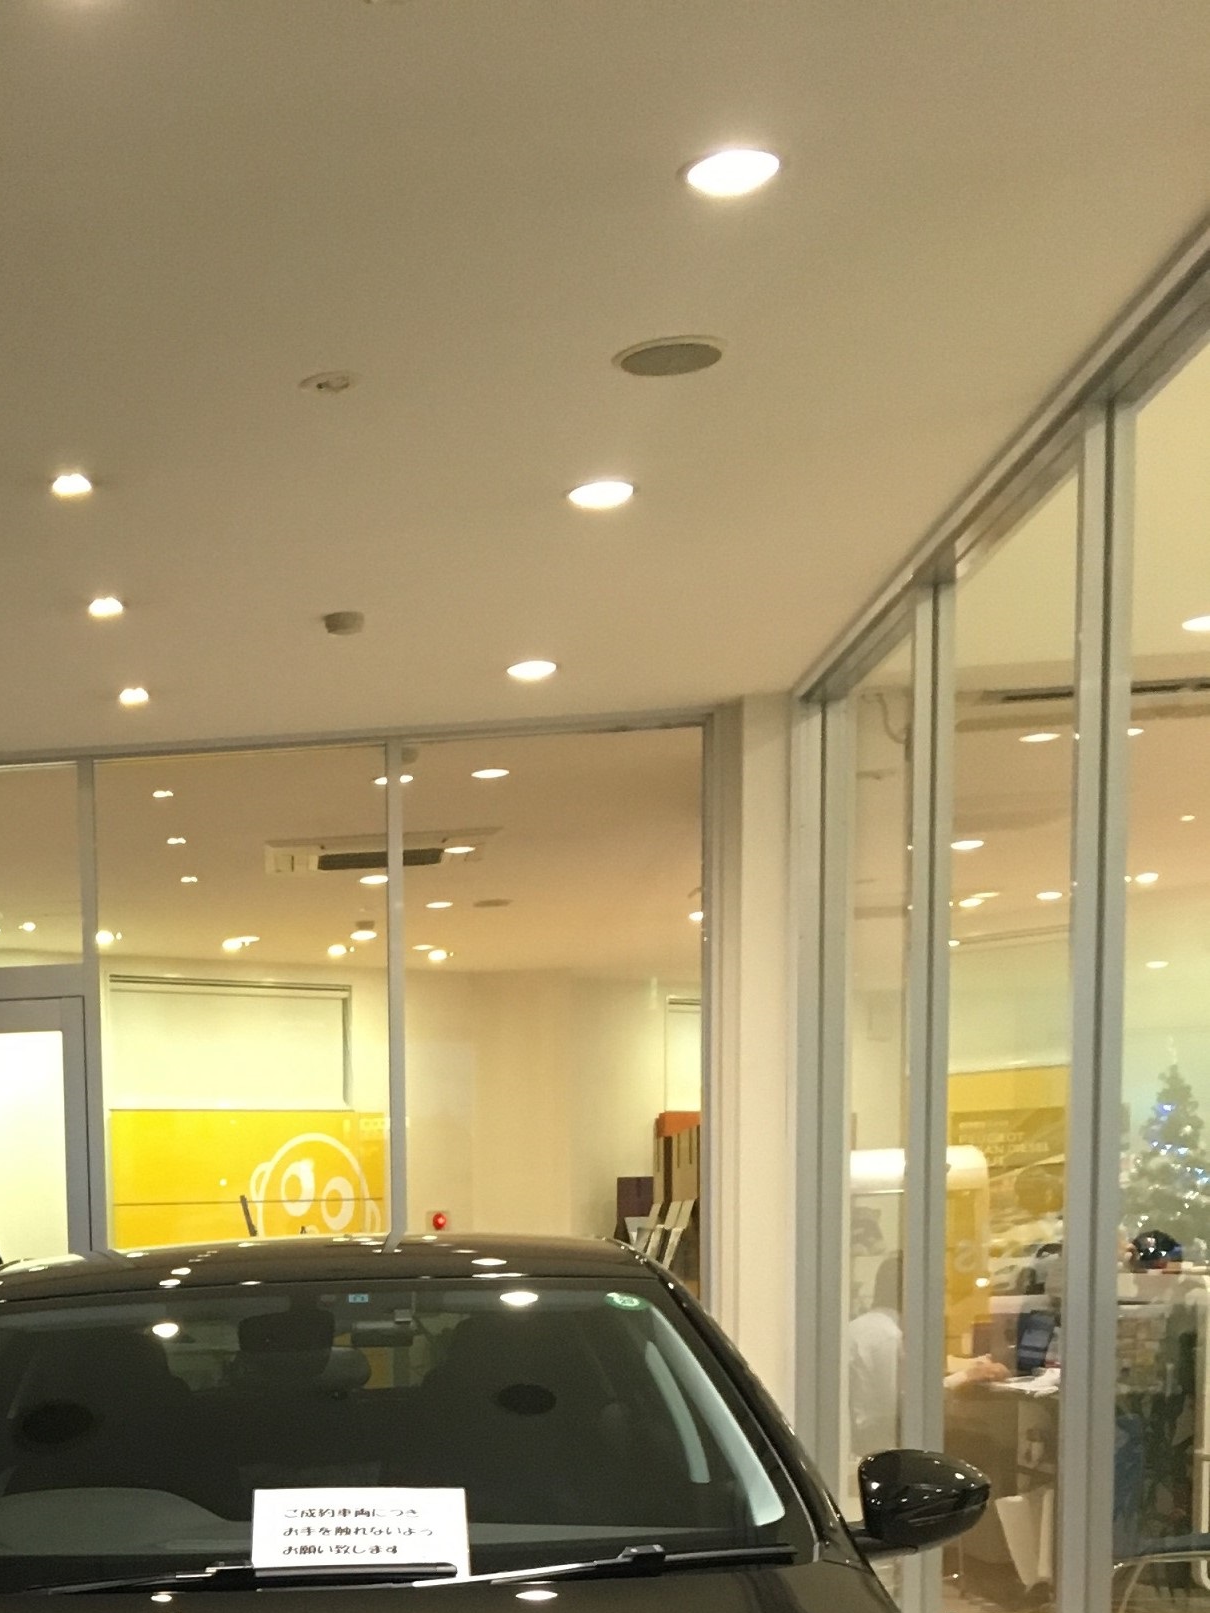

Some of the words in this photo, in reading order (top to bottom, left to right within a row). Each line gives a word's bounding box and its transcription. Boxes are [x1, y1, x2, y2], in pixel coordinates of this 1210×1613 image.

[284, 1508, 420, 1519] ご成約車両につき
[282, 1544, 398, 1556] お願い致します
